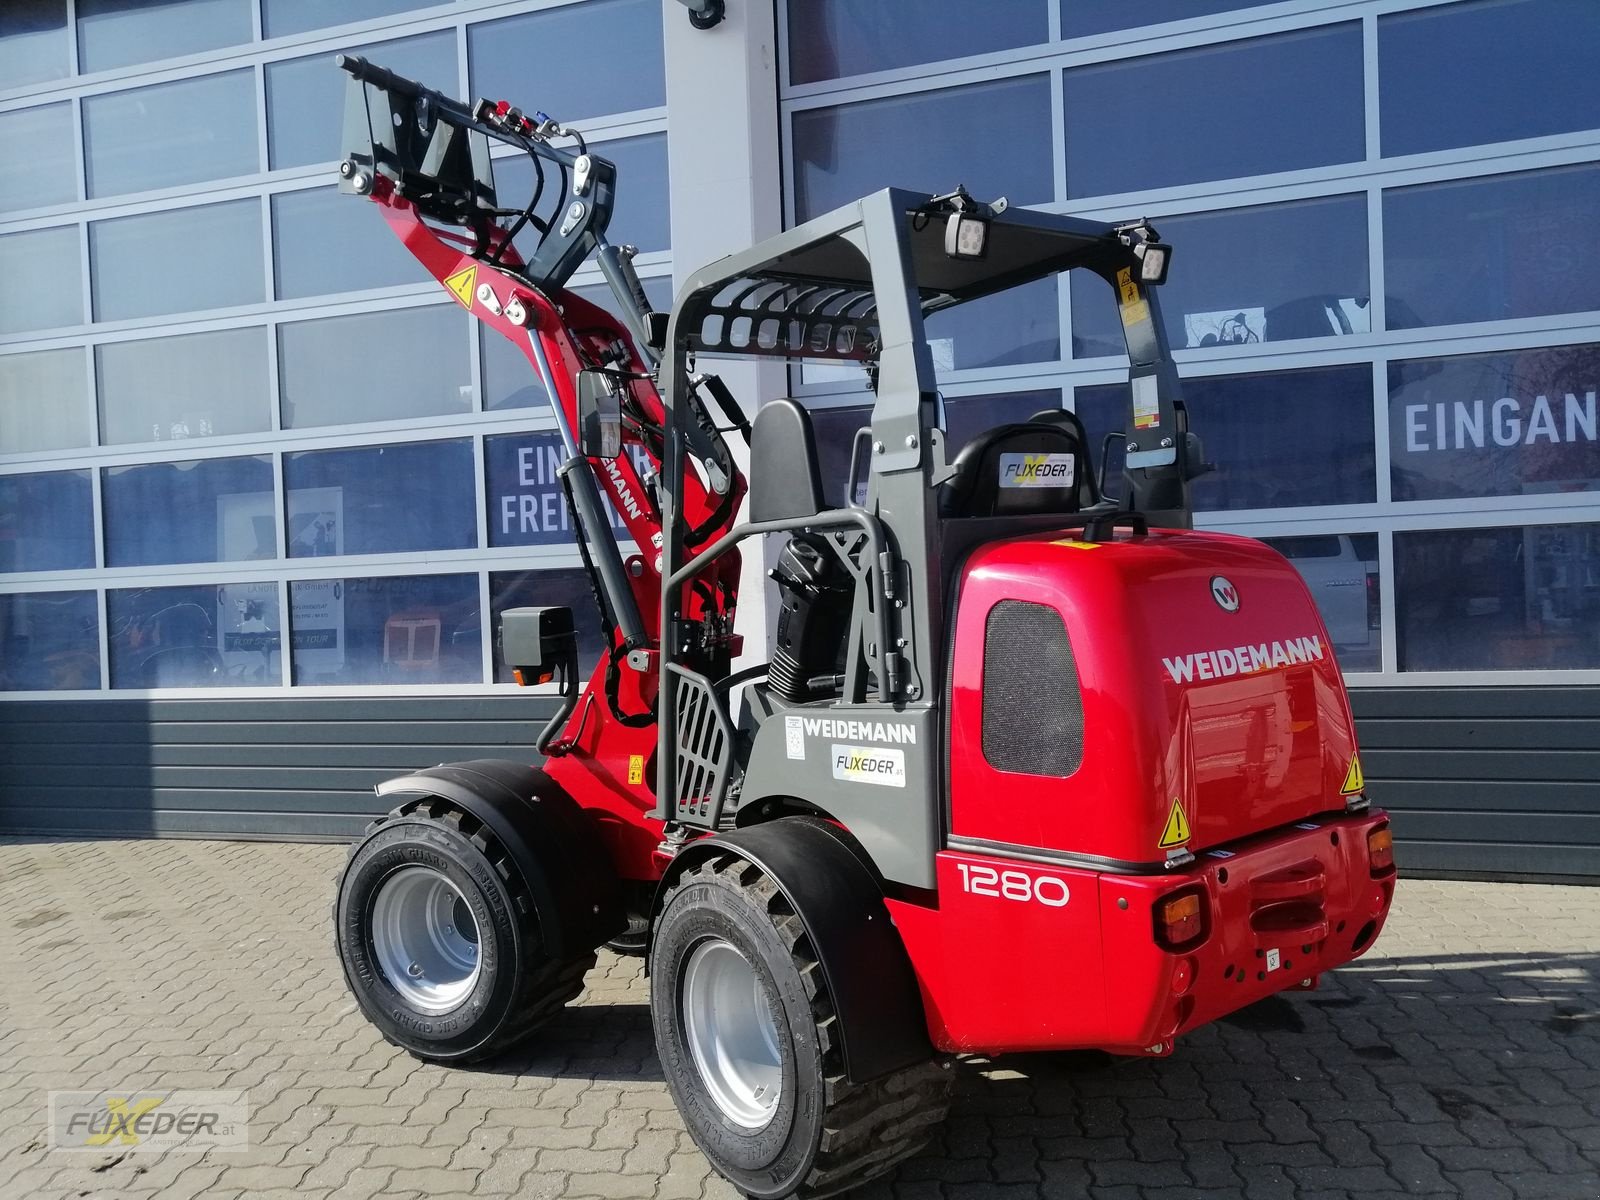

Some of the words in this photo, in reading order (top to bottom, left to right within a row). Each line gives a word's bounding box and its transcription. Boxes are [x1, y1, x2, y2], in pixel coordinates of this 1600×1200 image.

[1406, 391, 1597, 452] EINGAN
[601, 457, 642, 520] EMANN
[1162, 635, 1323, 684] WEIDEMANN
[803, 717, 917, 745] WEIDEMANN
[957, 863, 1070, 907] 1280
